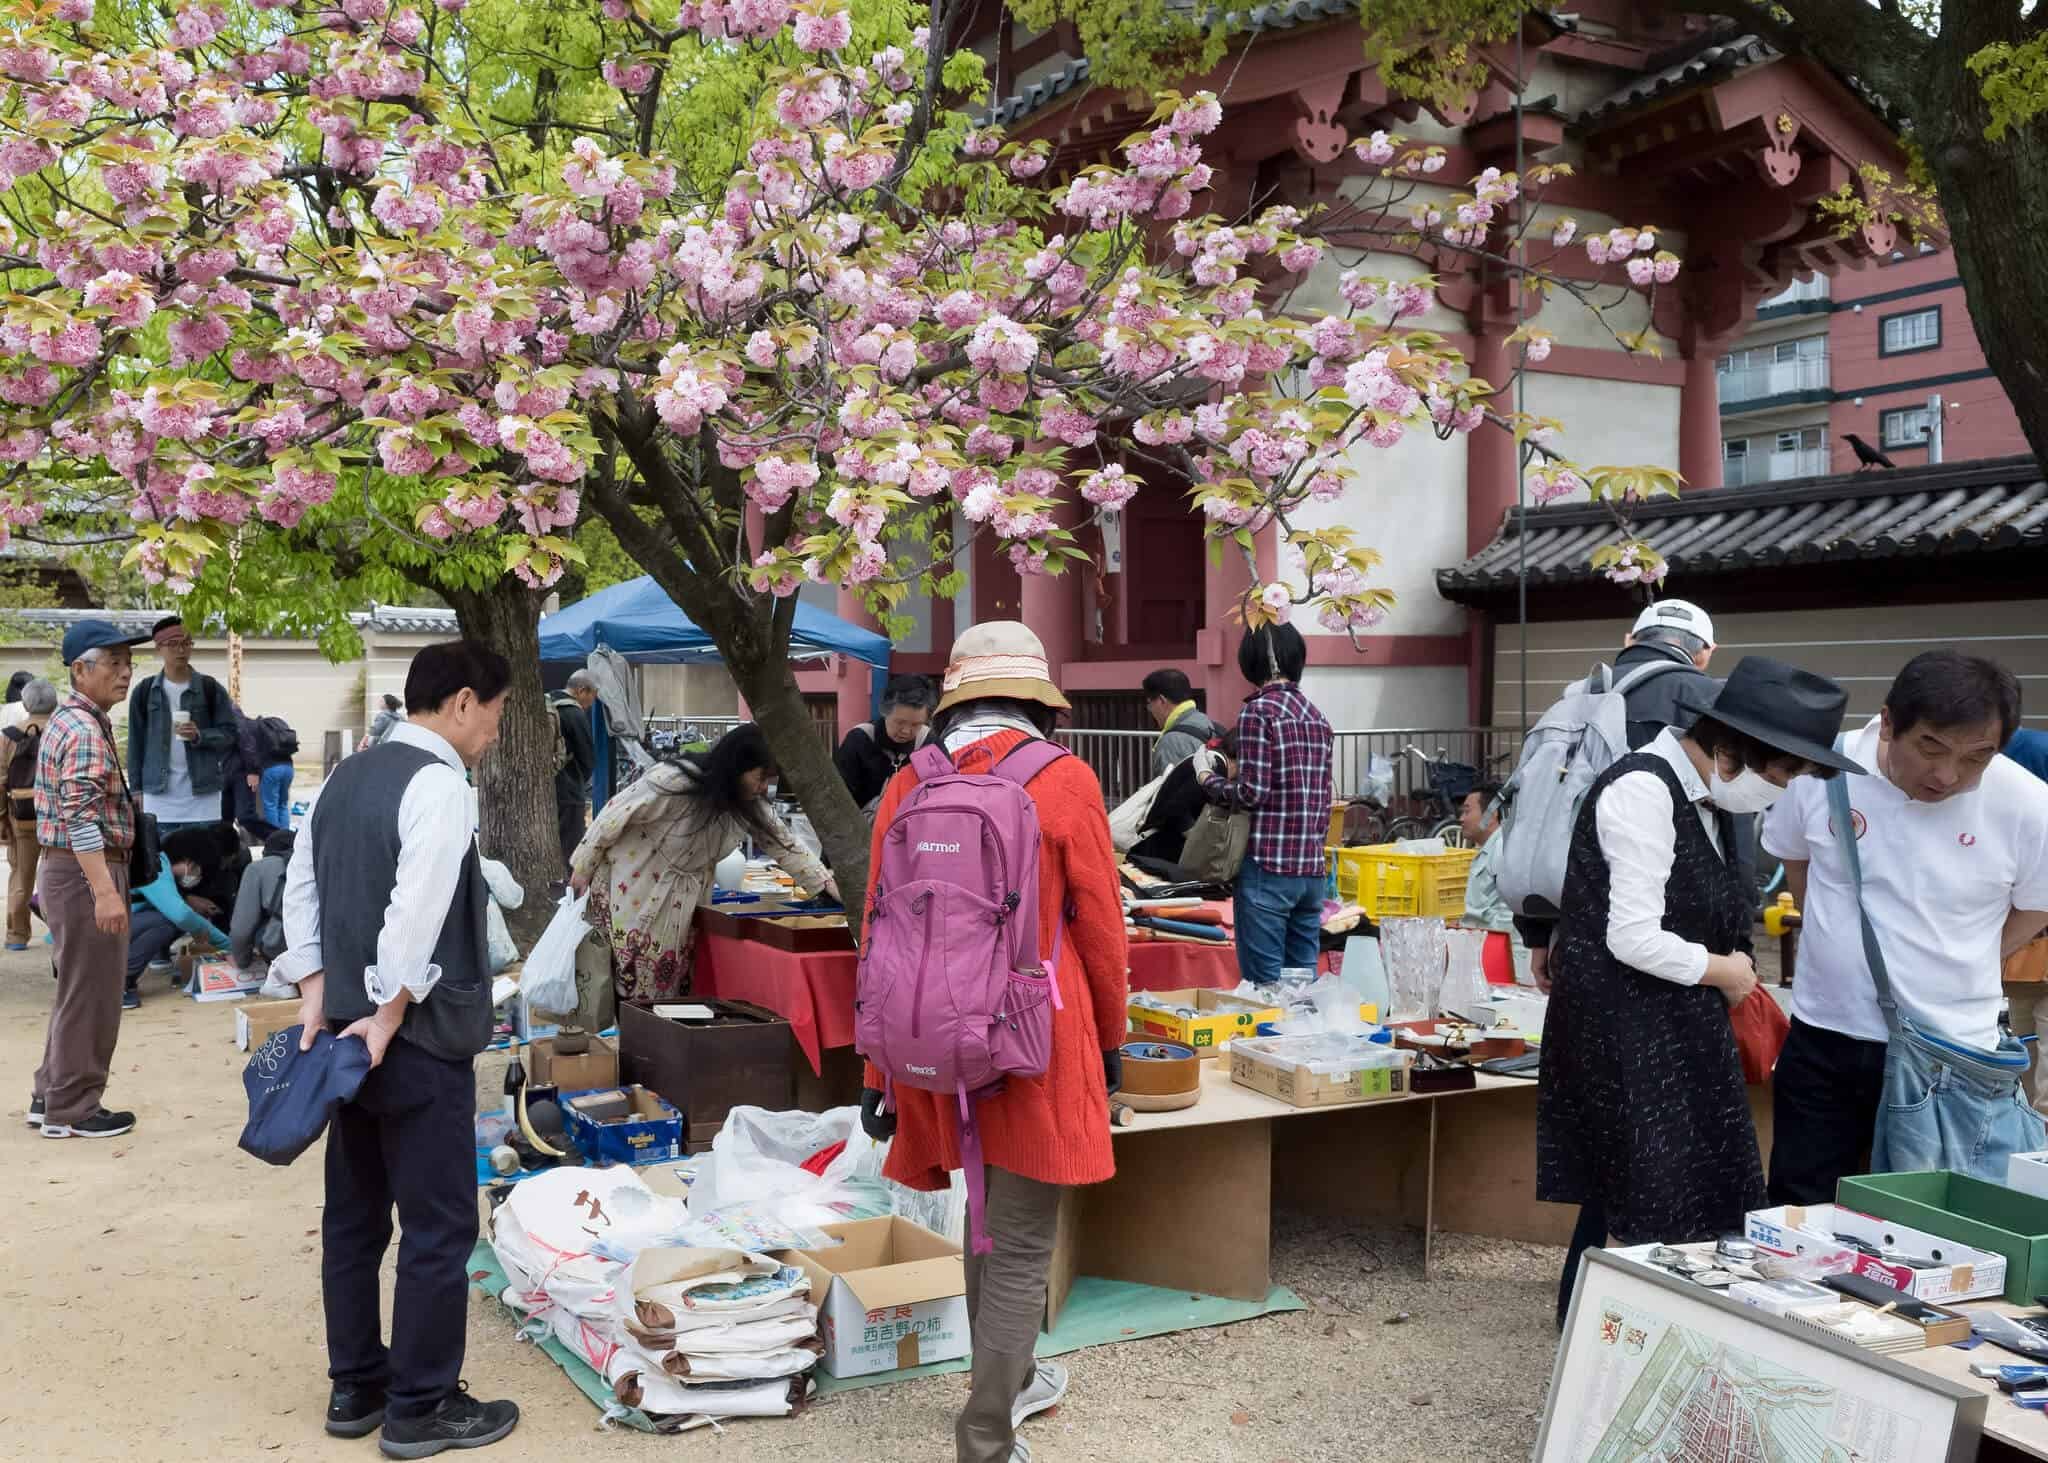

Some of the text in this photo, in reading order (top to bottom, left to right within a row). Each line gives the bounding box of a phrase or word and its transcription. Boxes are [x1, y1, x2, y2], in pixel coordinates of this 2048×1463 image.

[863, 1317, 943, 1344] 西吉野の柿
